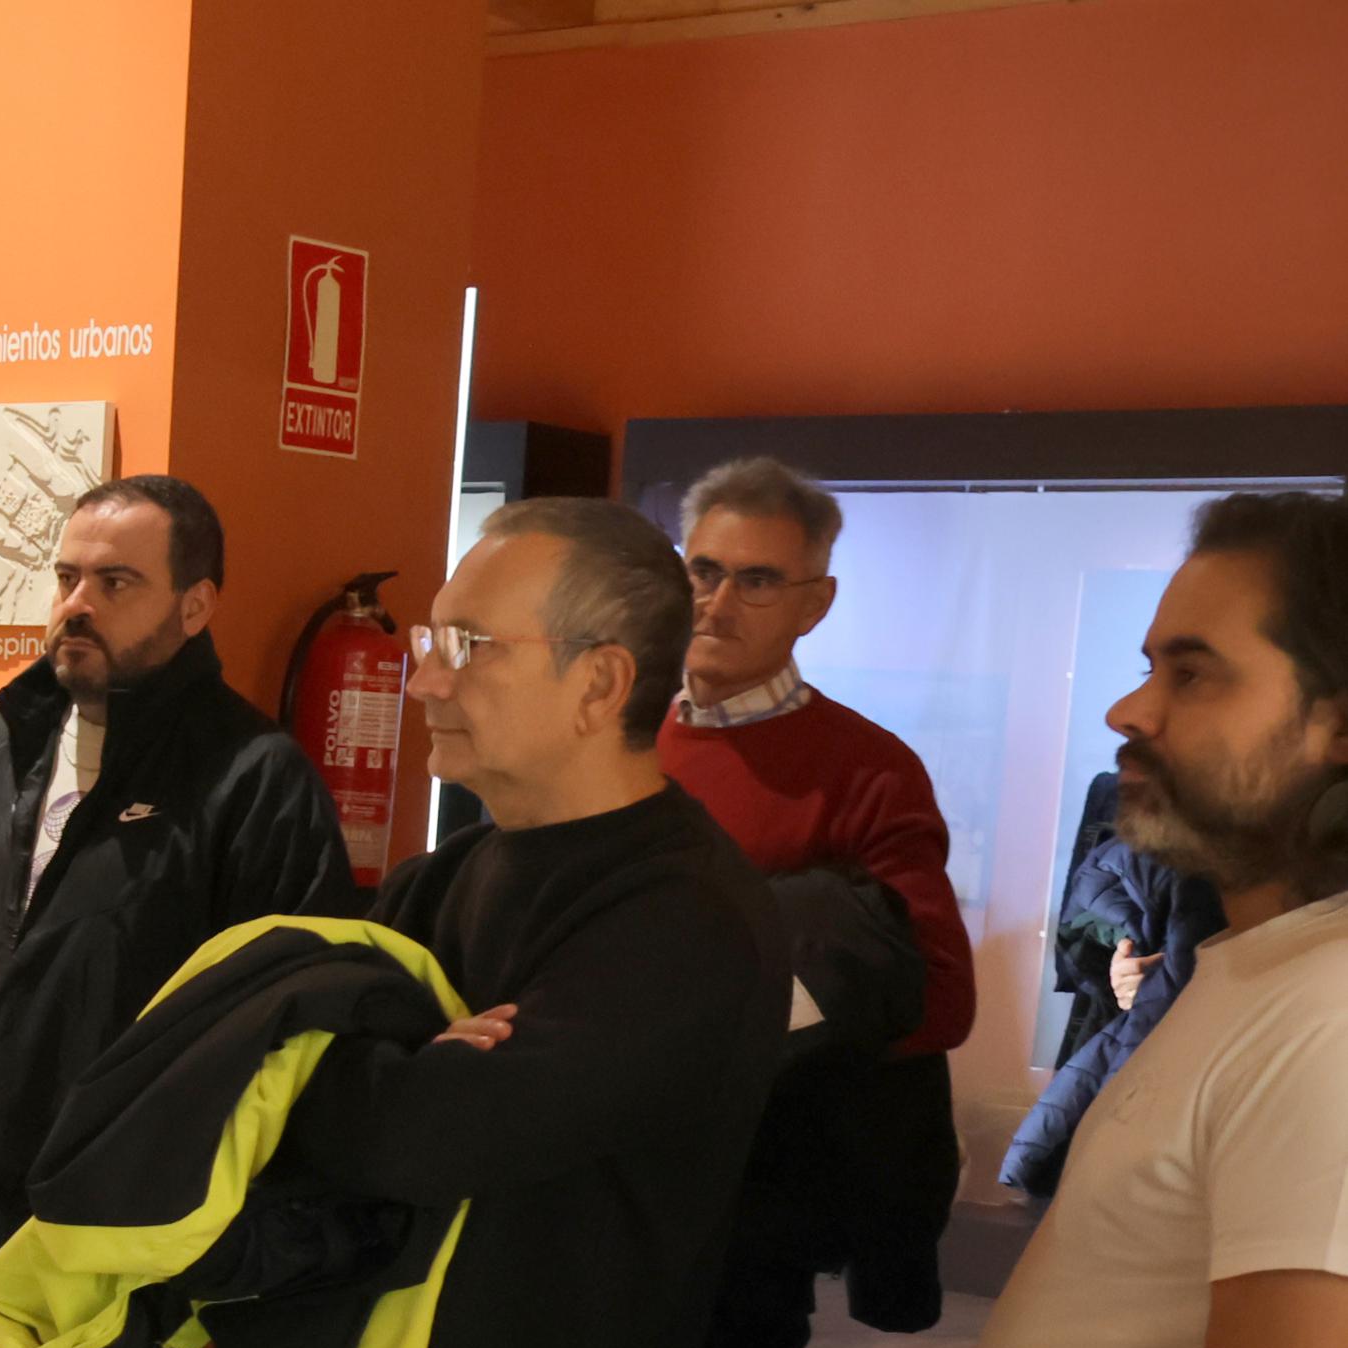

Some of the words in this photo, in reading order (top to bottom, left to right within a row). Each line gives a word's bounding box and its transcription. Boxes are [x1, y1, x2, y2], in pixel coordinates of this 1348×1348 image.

[70, 318, 153, 358] urbanos
[286, 401, 352, 441] EXTINTOR
[324, 690, 341, 766] POLVO
